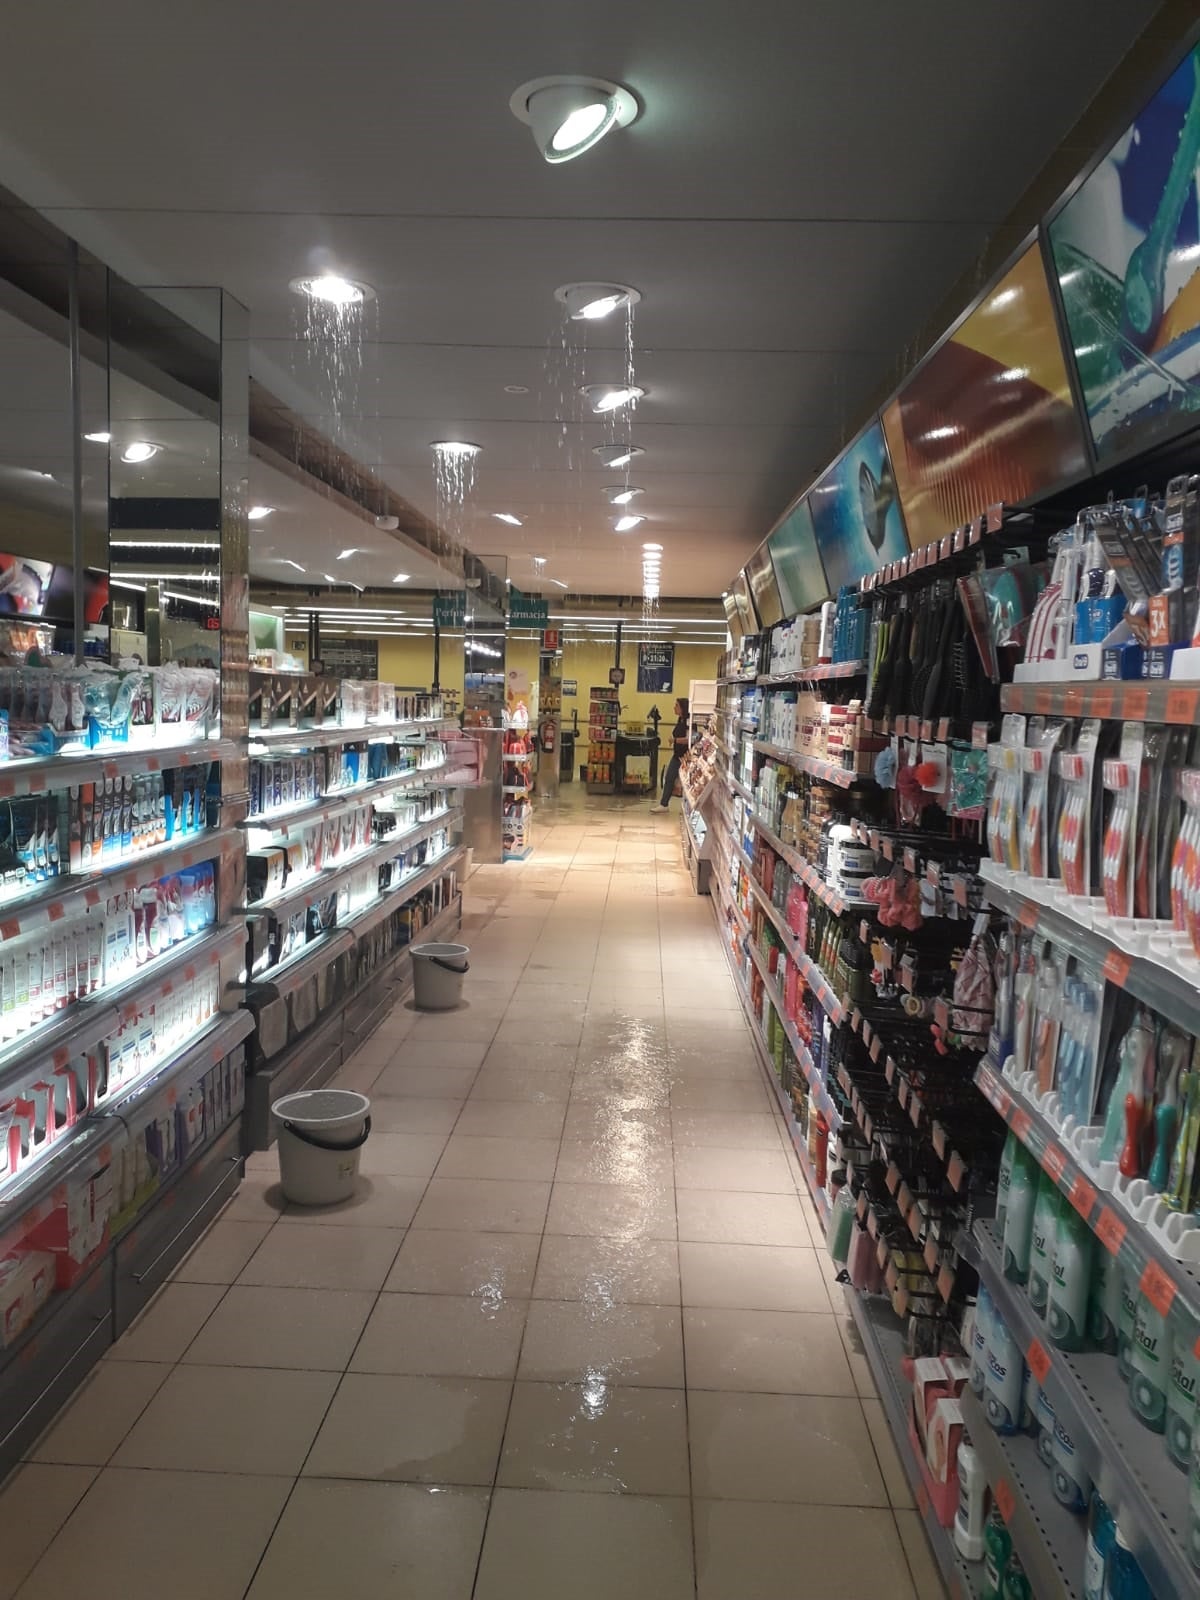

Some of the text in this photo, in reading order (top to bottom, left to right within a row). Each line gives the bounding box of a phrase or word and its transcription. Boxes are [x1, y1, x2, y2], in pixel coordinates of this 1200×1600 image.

[511, 610, 546, 619] armacia
[1136, 1327, 1157, 1351] otal
[1168, 1366, 1195, 1392] otal
